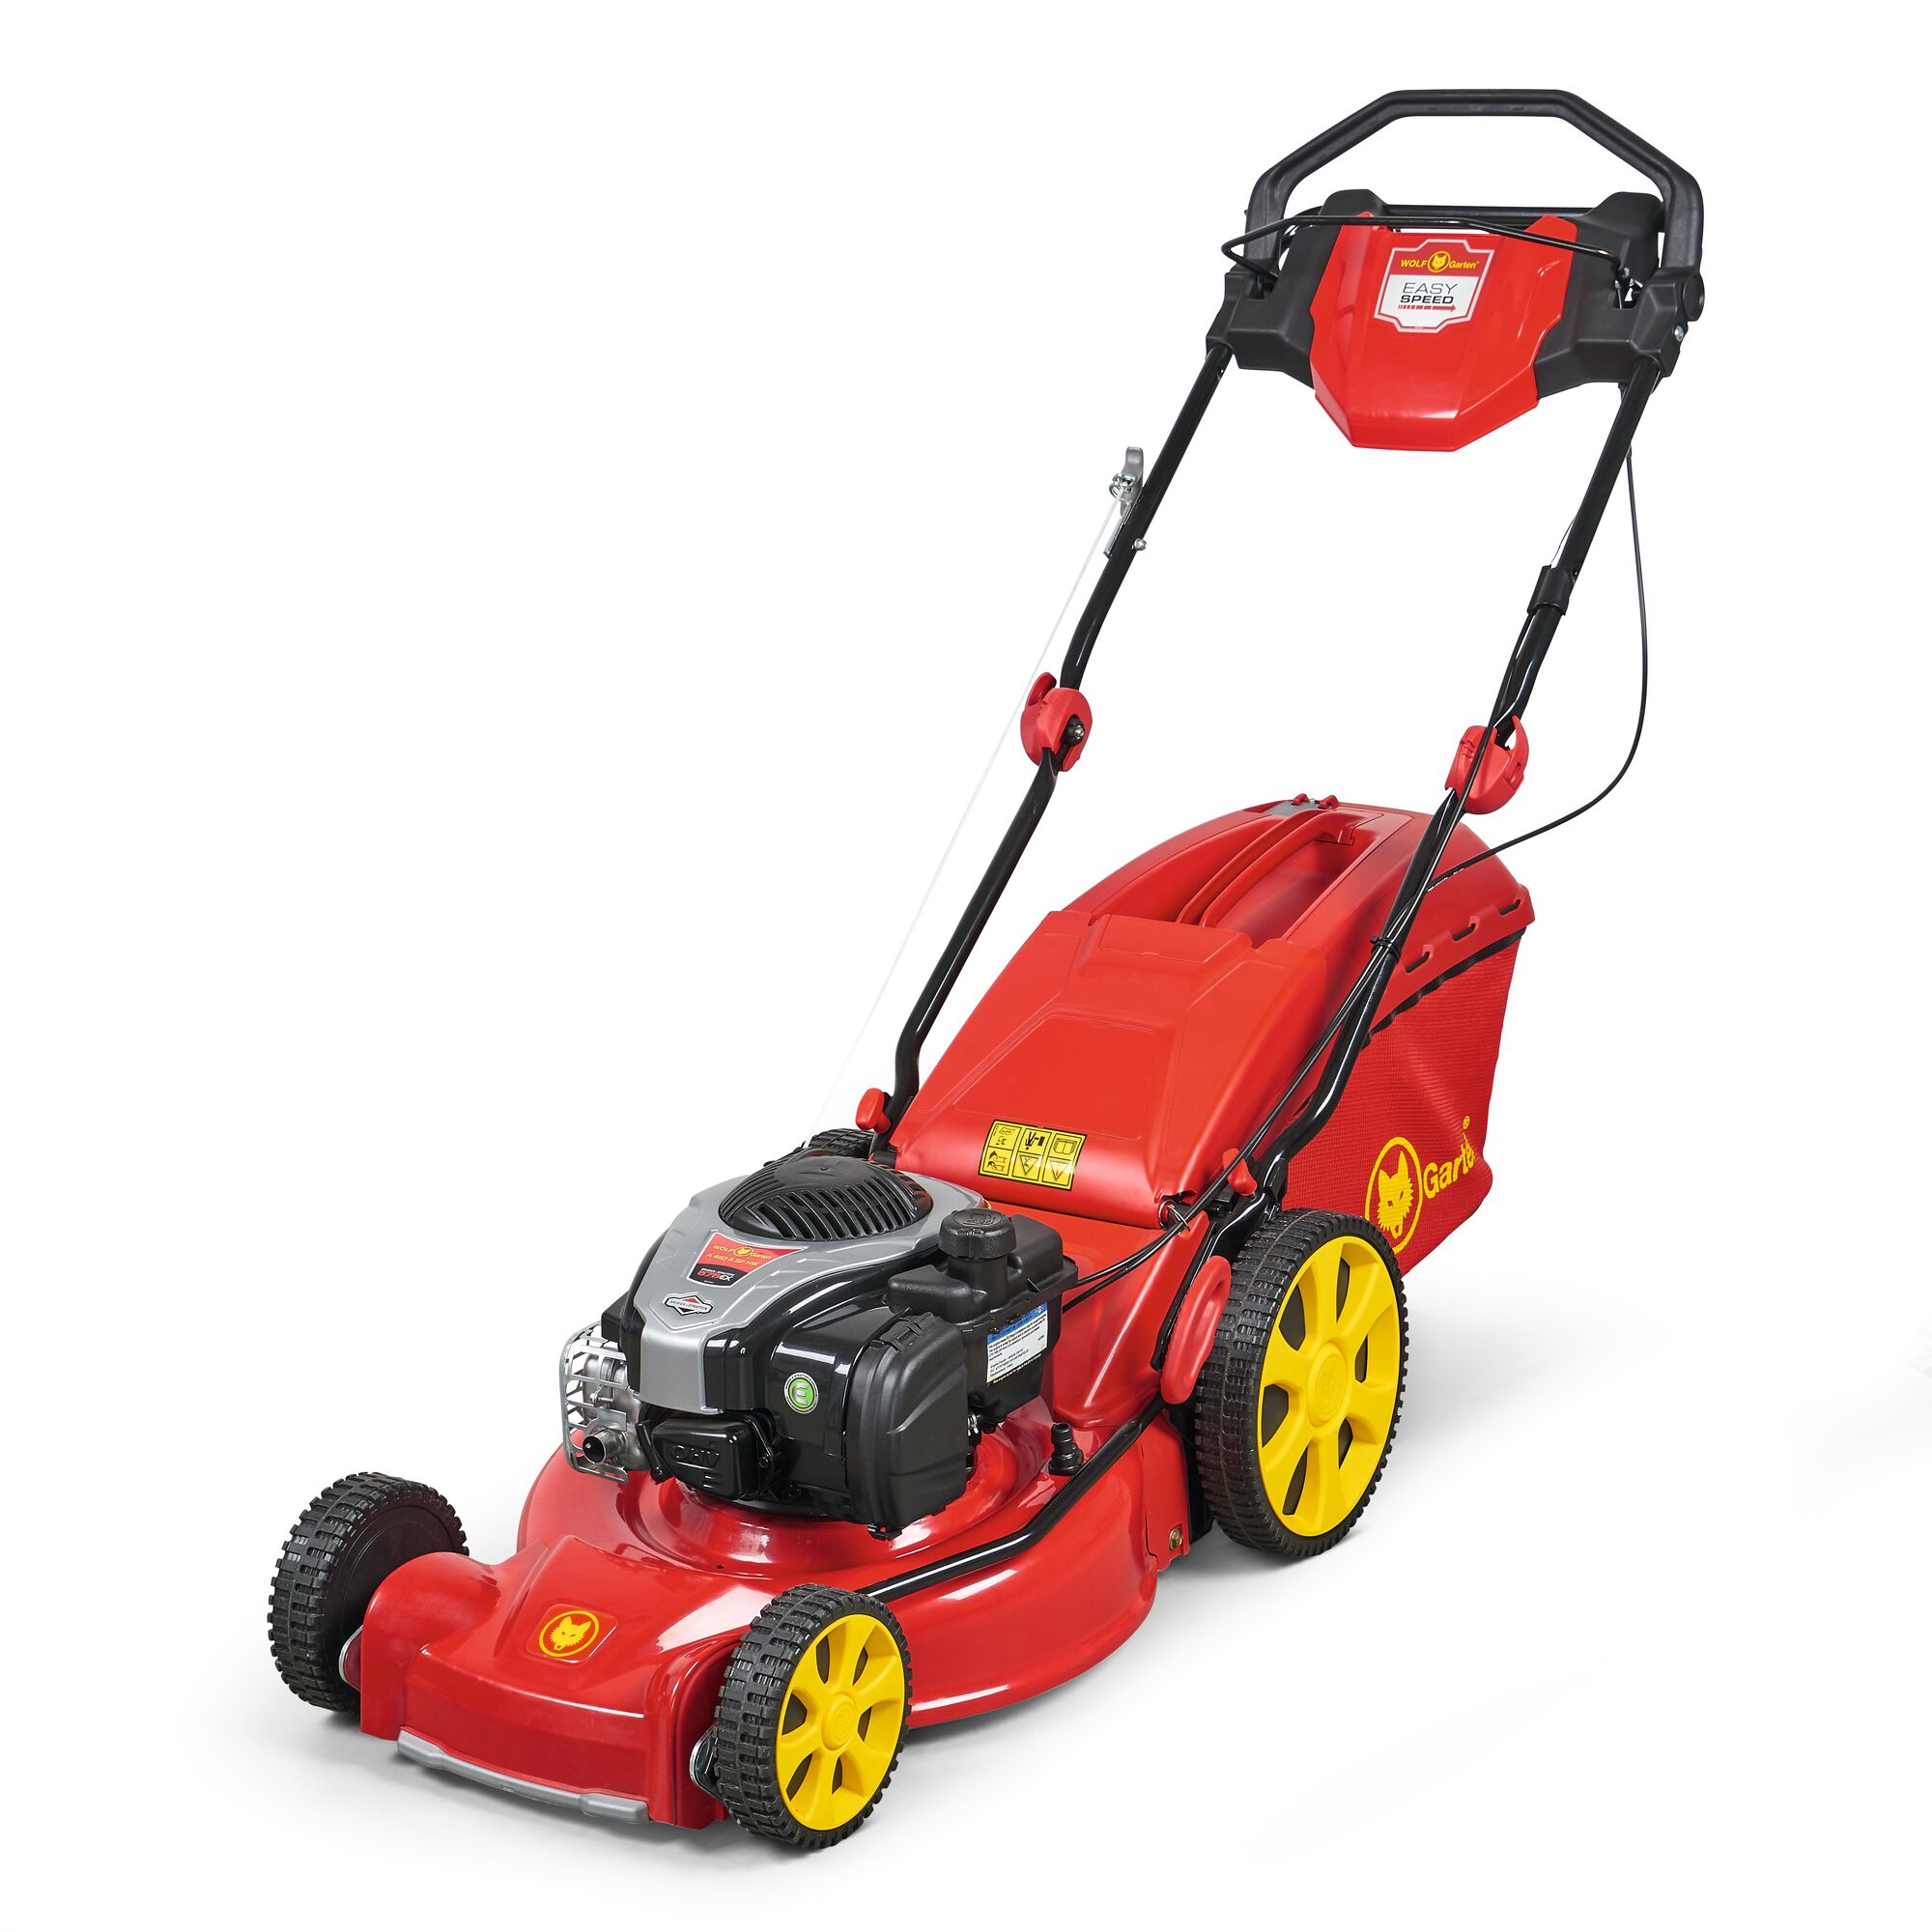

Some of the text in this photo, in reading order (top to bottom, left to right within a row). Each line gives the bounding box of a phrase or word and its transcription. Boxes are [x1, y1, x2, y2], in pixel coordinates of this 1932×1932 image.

[1400, 259, 1428, 268] WOLF
[1403, 282, 1459, 295] EASY
[1400, 295, 1454, 304] SPEED
[713, 1244, 734, 1253] WOLF
